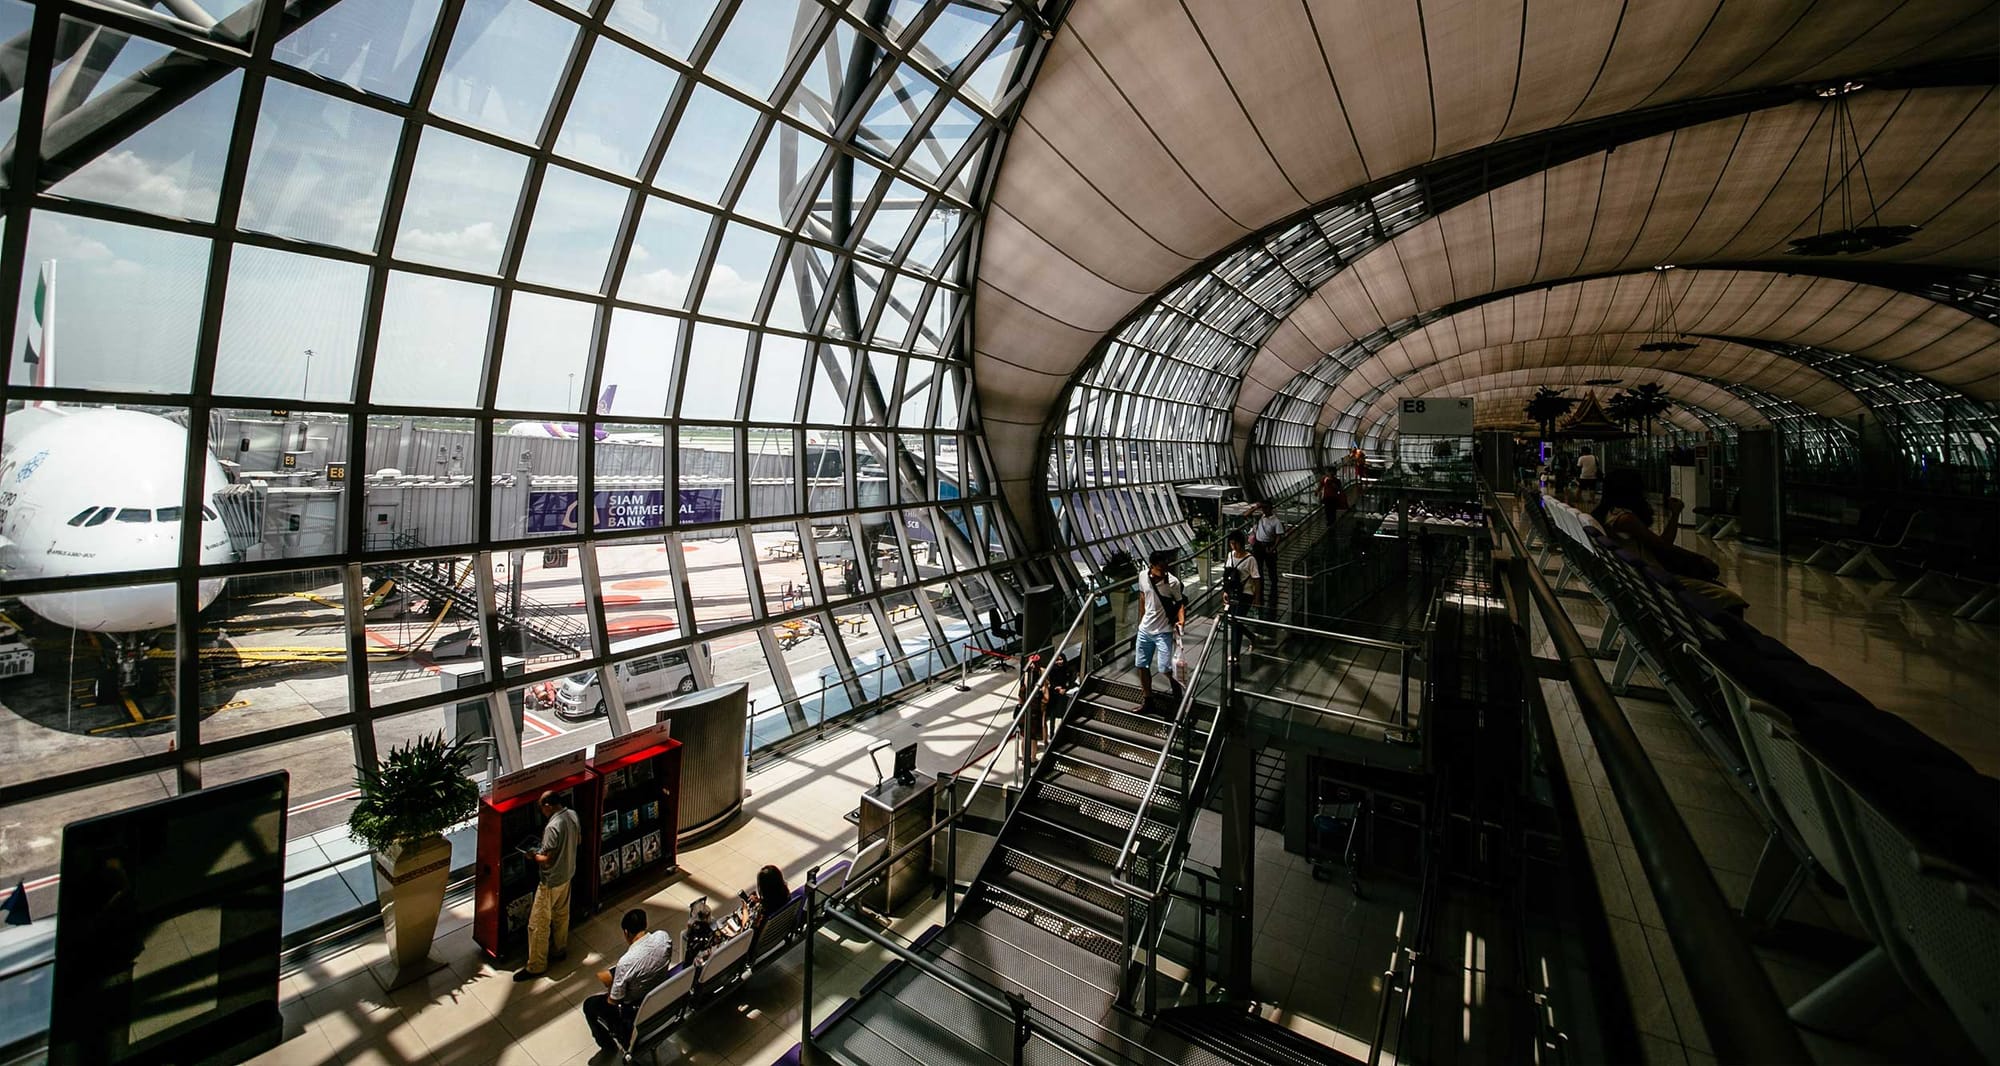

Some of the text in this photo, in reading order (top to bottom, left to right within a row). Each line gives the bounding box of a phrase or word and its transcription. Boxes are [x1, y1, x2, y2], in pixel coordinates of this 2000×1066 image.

[1403, 400, 1425, 413] E8
[285, 455, 295, 465] E8
[329, 467, 345, 479] E8
[609, 495, 644, 506] SIAM
[608, 516, 646, 528] BANK
